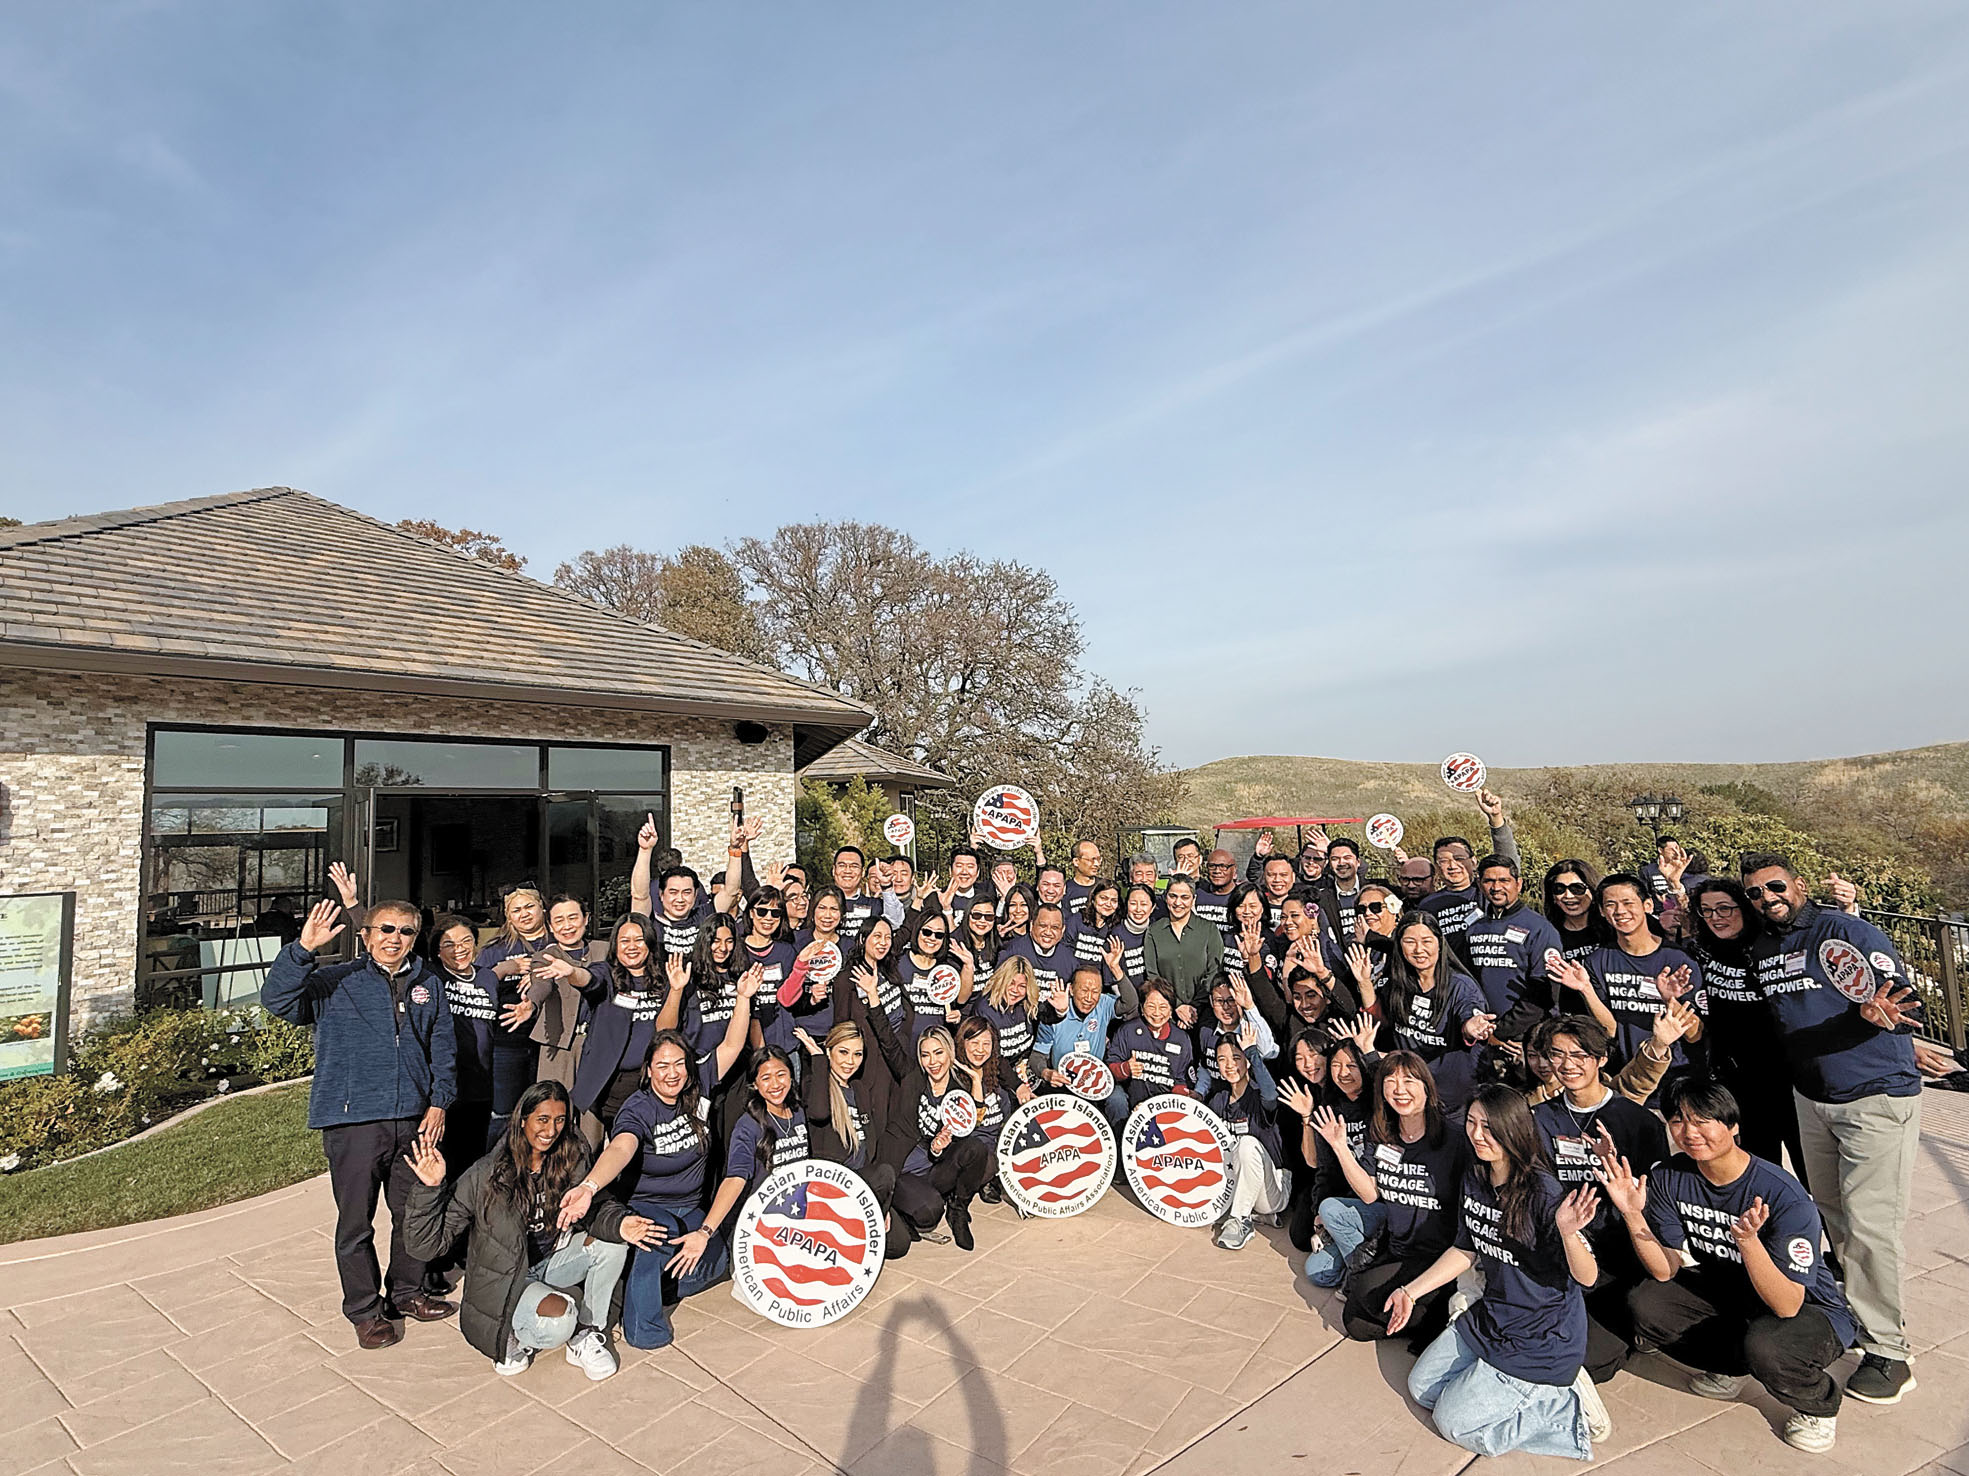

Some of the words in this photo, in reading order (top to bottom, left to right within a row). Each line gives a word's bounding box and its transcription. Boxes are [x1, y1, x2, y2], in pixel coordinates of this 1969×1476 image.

[988, 810, 1022, 829] APAPA
[1759, 953, 1785, 970] INSPI
[1837, 963, 1859, 982] APAPA
[1705, 972, 1746, 989] NGAGE.
[1763, 977, 1823, 997] MPOWER.
[1707, 985, 1763, 1001] POWER.
[449, 1003, 497, 1020] MPOWER.
[1136, 1051, 1171, 1066] NSPIRE.
[1143, 1062, 1171, 1076] GAGE.
[655, 1123, 692, 1149] ENGAG
[1000, 1120, 1021, 1157] Asian
[1022, 1097, 1066, 1119] Pacific
[1072, 1100, 1111, 1142] Islander
[1125, 1113, 1146, 1145] Asian
[1147, 1098, 1187, 1114] Pacific
[1193, 1107, 1231, 1153] Islander
[655, 1134, 699, 1155] EMPOW
[1040, 1148, 1081, 1168] APAPA
[1152, 1154, 1205, 1171] APAPA
[1001, 1170, 1031, 1208] American
[1032, 1201, 1057, 1216] Public
[1059, 1201, 1085, 1215] Affairs
[1085, 1153, 1114, 1203] Association
[1127, 1168, 1167, 1216] American
[1174, 1210, 1208, 1224] Public
[1212, 1178, 1235, 1213] Affairs
[1377, 1187, 1442, 1210] MPOWER.
[757, 1171, 796, 1204] Asian
[805, 1165, 853, 1190] Pacific
[856, 1190, 881, 1256] Islander
[1677, 1201, 1740, 1226] NSPIRE
[1465, 1214, 1503, 1243] NGAGE.
[776, 1226, 838, 1266] APAPA
[1471, 1235, 1520, 1266] POWER.
[1690, 1237, 1743, 1264] MPOW
[738, 1228, 764, 1302] American
[768, 1299, 812, 1323] Public
[822, 1285, 864, 1320] Affairs
